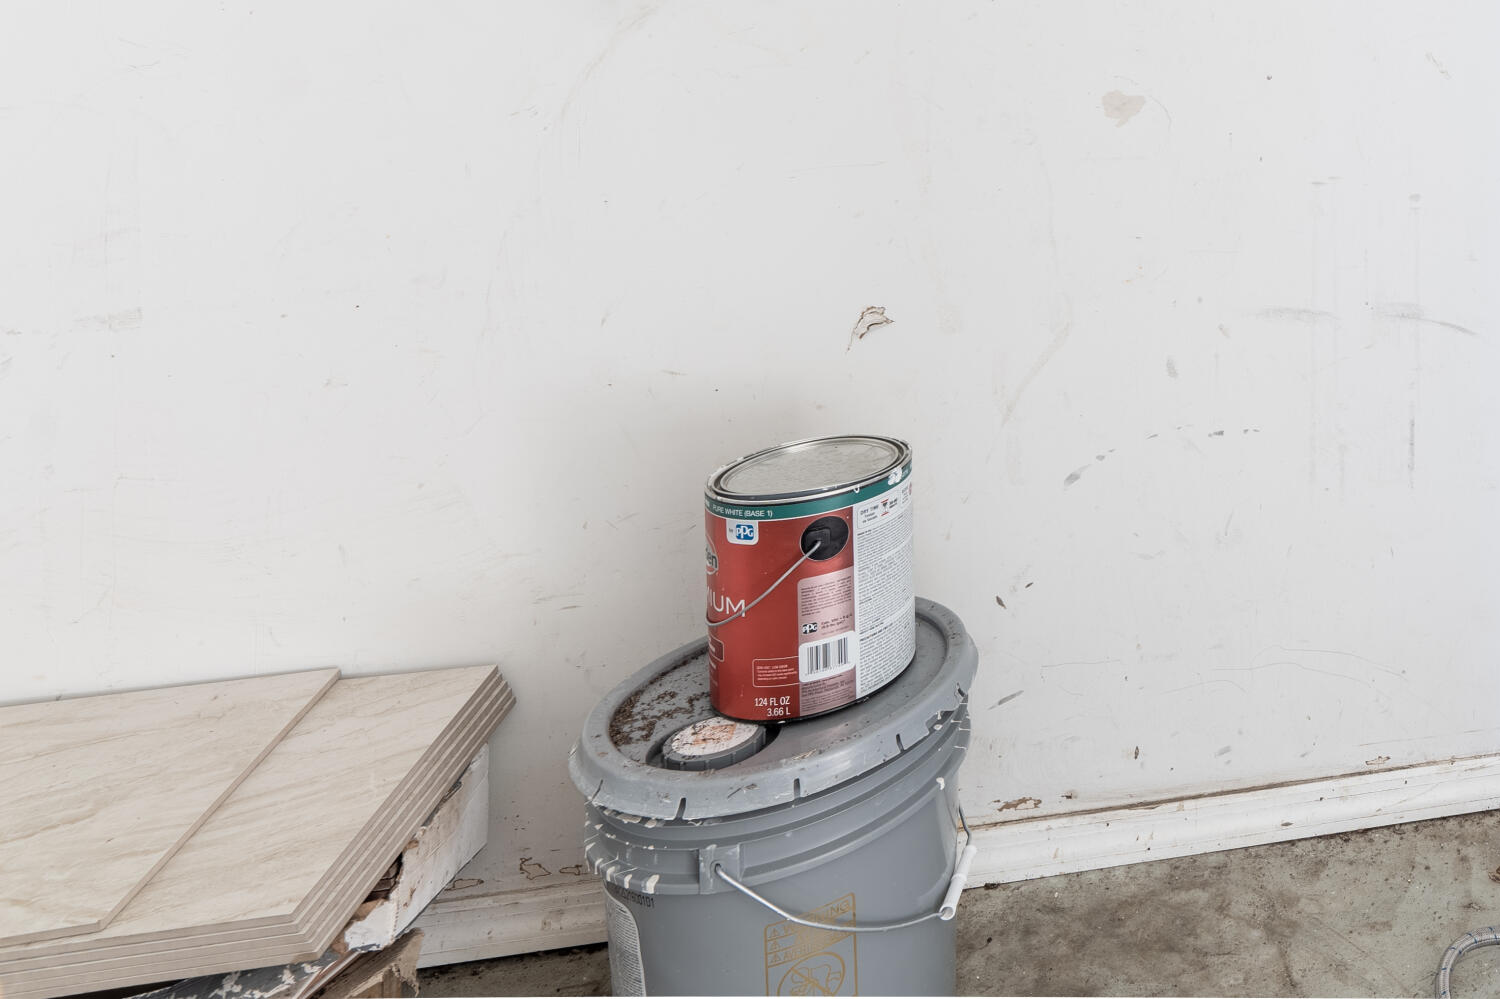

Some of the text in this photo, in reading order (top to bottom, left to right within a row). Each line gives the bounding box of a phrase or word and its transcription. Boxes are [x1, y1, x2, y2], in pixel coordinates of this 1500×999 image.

[713, 505, 724, 513] PURE
[725, 508, 743, 516] WHITE
[767, 510, 773, 518] 1)
[736, 526, 754, 539] PPG
[705, 548, 718, 569] en
[707, 585, 746, 617] IUM
[803, 622, 818, 634] PPG
[755, 696, 790, 707] 124 FL OZ
[767, 707, 791, 717] 3.66 L
